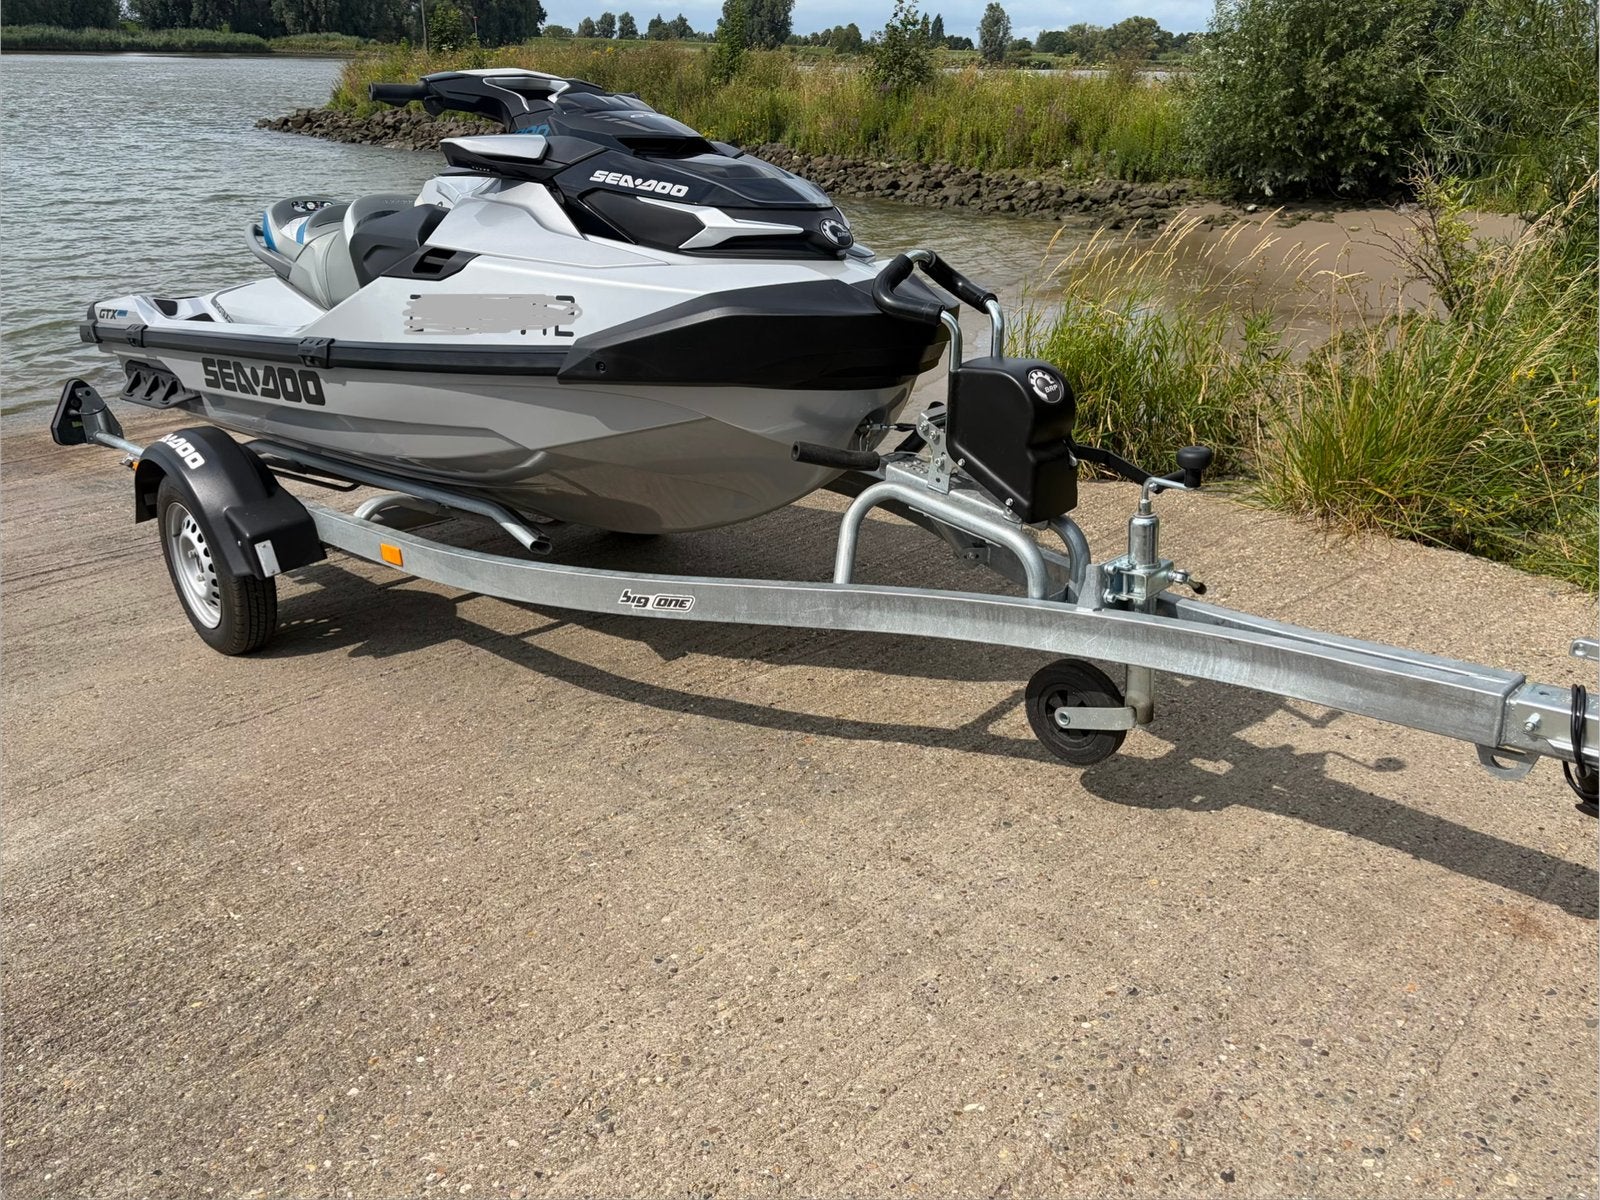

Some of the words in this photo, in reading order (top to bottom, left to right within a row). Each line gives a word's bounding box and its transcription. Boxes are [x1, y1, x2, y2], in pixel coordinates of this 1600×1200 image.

[99, 309, 118, 319] GTX
[1045, 384, 1057, 393] BRP
[620, 590, 650, 608] big
